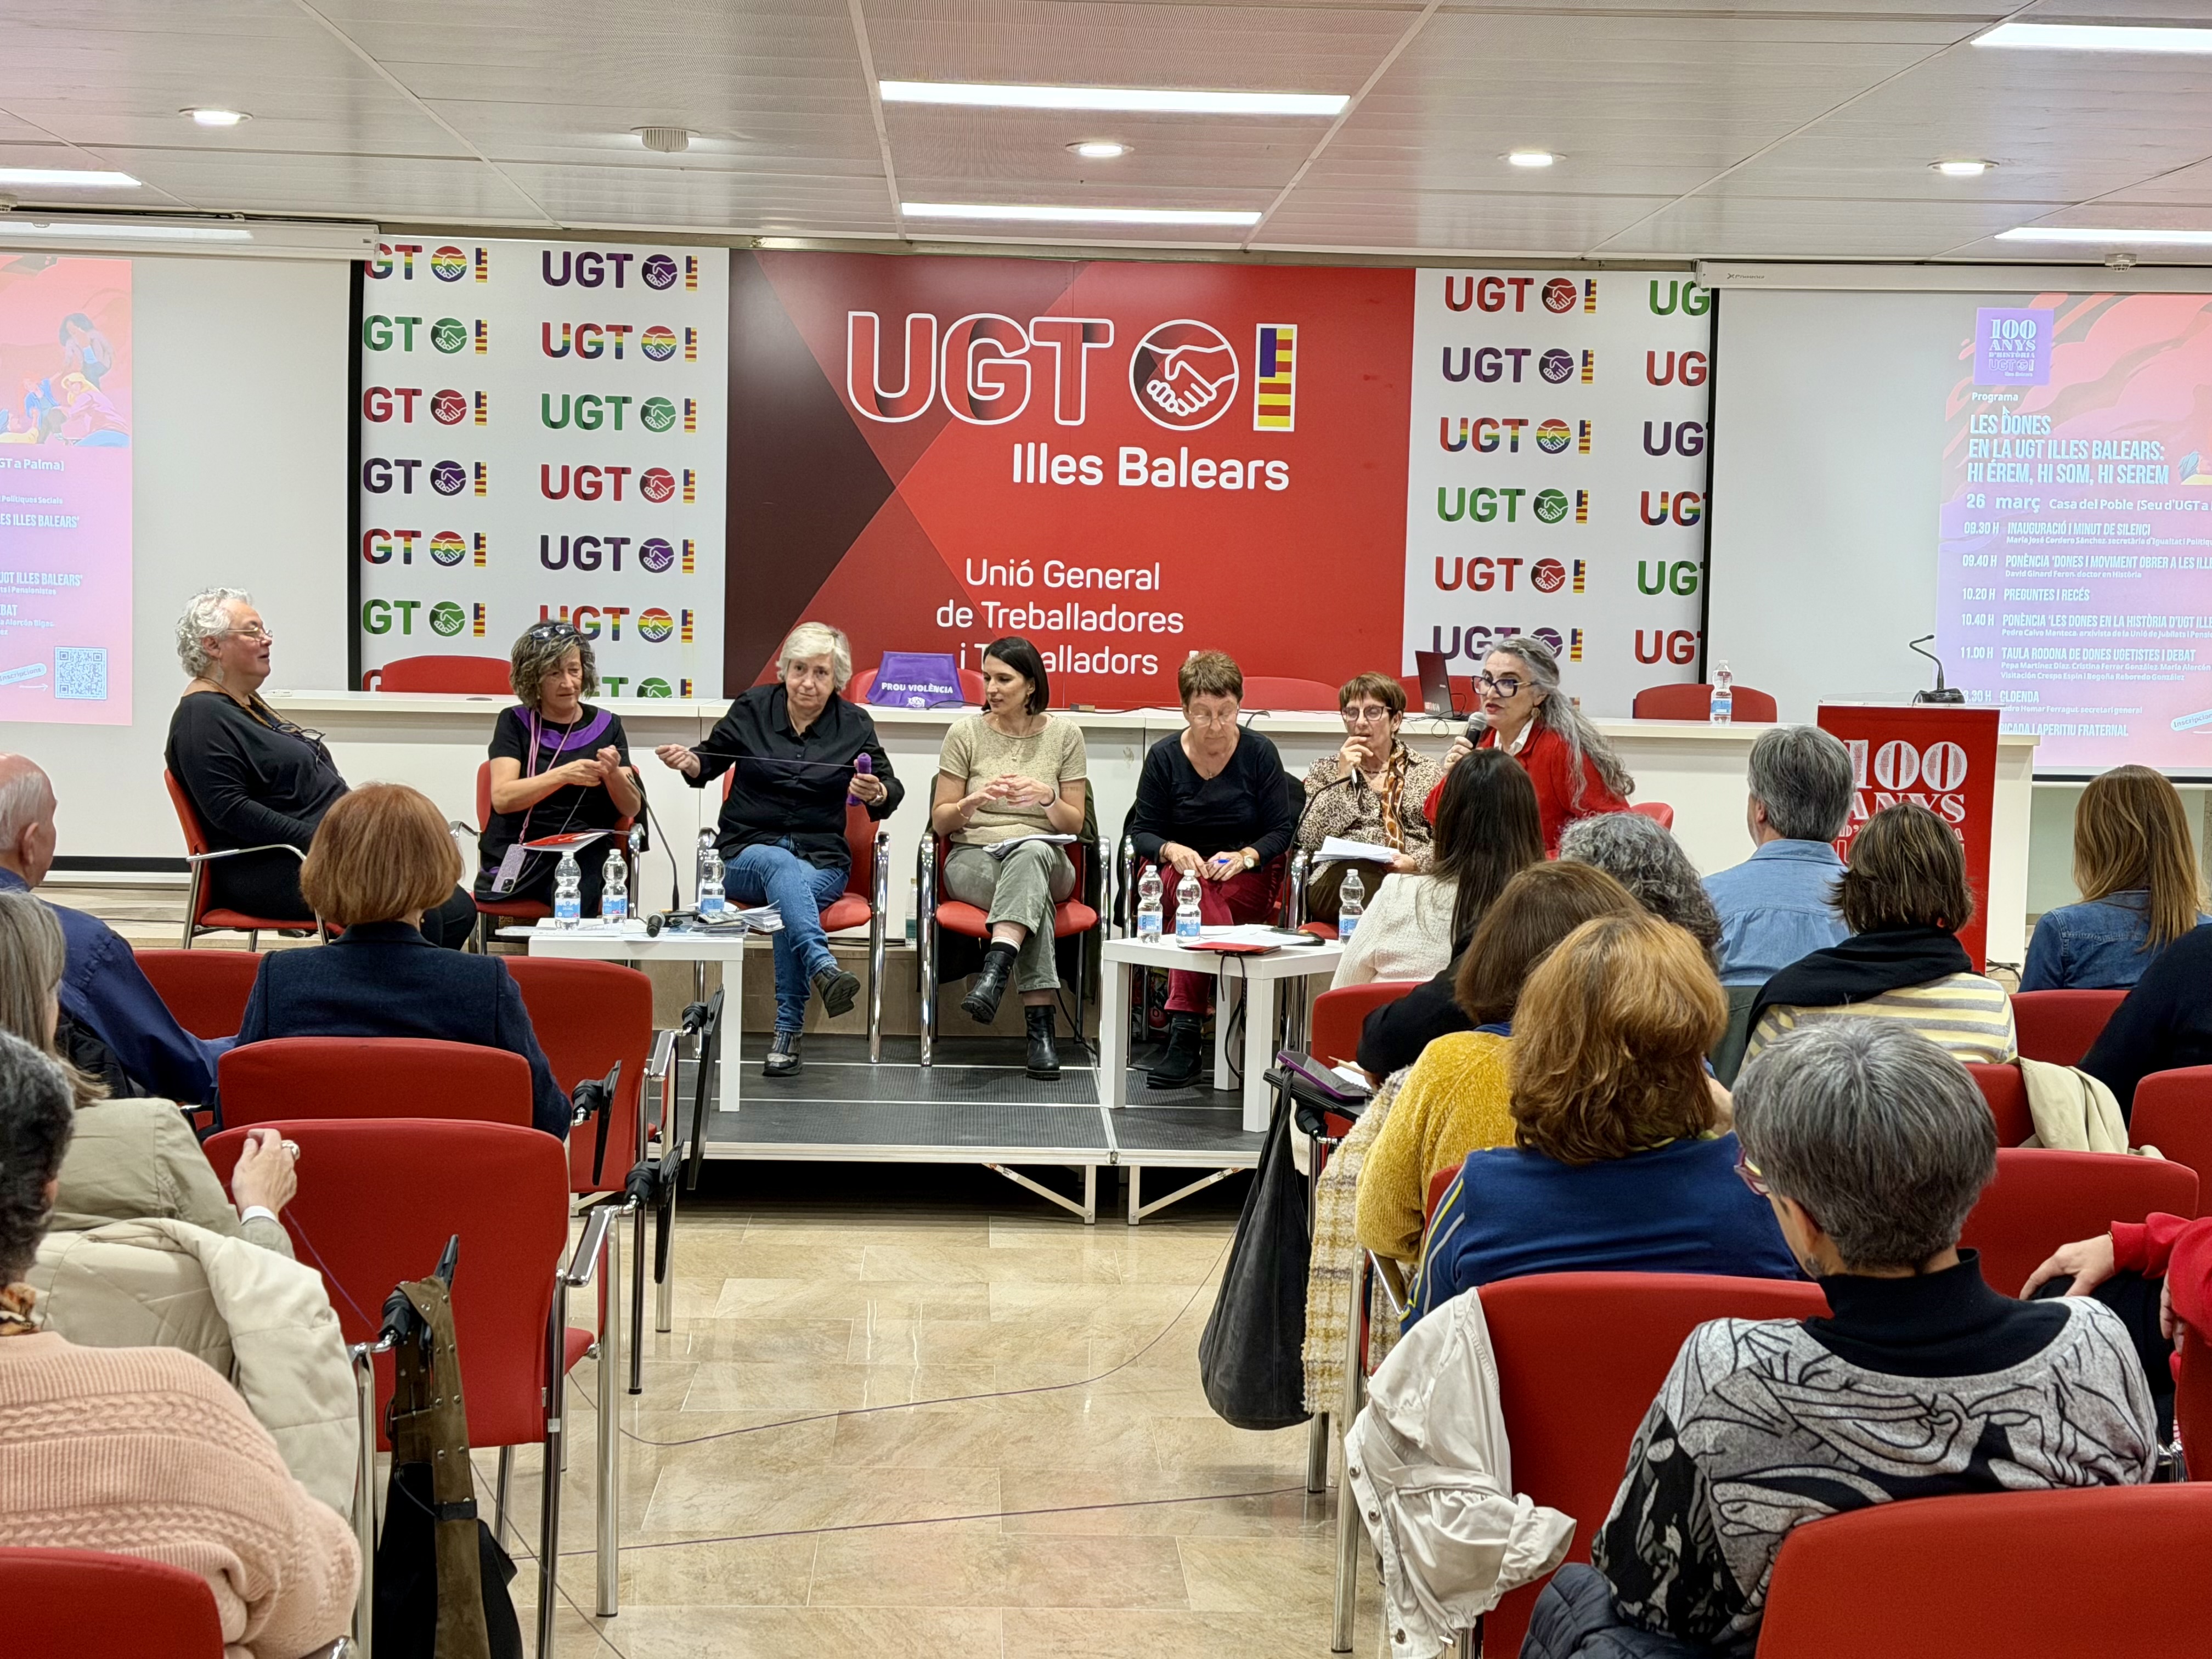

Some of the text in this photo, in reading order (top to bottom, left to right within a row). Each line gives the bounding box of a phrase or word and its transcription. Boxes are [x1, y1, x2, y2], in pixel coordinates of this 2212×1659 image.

[542, 250, 634, 289] UGT
[1445, 276, 1534, 312] UGT
[542, 322, 633, 360] UGT
[1989, 319, 2036, 340] 100
[1989, 340, 2036, 352] ANYS
[848, 311, 1114, 426] UGT
[1442, 347, 1531, 383] UGT
[541, 393, 633, 431] UGT
[1972, 392, 2018, 403] Programa
[1440, 417, 1528, 453] UGT
[1970, 414, 2052, 435] LES DONES
[1969, 438, 2165, 461] EN LA UGT ILLES BALEARS:
[541, 464, 631, 501] UGT
[1013, 442, 1290, 491] Illes Balears
[1967, 459, 2169, 486] HI ÉREM, HI SOM, HI SEREM
[1437, 487, 1526, 522] UGT
[1640, 491, 1707, 527] UG
[1966, 493, 1985, 509] 26
[1995, 496, 2041, 514] març
[2049, 498, 2077, 510] Casa
[2079, 499, 2097, 510] del
[2100, 499, 2134, 510] Poble
[2164, 499, 2200, 511] d'UGT
[2202, 503, 2209, 511] a
[0, 514, 11, 526] ES
[13, 514, 36, 526] ILLES
[1993, 522, 1999, 534] H
[2007, 520, 2067, 535] INAUGURACIÓ
[2073, 522, 2102, 535] MINUT
[2103, 523, 2115, 535] DE
[2117, 523, 2151, 536] SILENCI
[540, 534, 631, 572] UGT
[1962, 554, 1989, 567] 09.40
[1990, 555, 1997, 567] H
[2006, 553, 2050, 567] PONÈNCIA
[2090, 555, 2138, 568] MOVIMENT
[2140, 556, 2169, 569] OBRER
[2170, 556, 2176, 569] A
[2178, 556, 2195, 569] LES
[16, 572, 40, 584] ILLES
[966, 558, 1160, 590] Unió General
[1435, 556, 1523, 592] UGT
[1638, 561, 1703, 596] UG
[1962, 588, 1987, 600] 10.20
[1989, 588, 1995, 601] H
[2004, 588, 2055, 601] PREGUNTES
[2062, 586, 2090, 601] RECÉS
[0, 605, 18, 616] BAT
[936, 599, 1184, 634] de Treballadores
[1962, 613, 1985, 625] 10.40
[1988, 613, 1994, 626] H
[2002, 612, 2046, 626] PONÈNCIA
[2069, 615, 2097, 627] DONES
[2100, 615, 2111, 627] EN
[2113, 615, 2124, 627] LA
[2126, 613, 2166, 628] HISTÒRIA
[960, 642, 1158, 675] i Talladors
[1635, 629, 1701, 664] UG
[1961, 646, 1985, 658] 11.00
[1987, 646, 1993, 658] H
[2001, 647, 2029, 659] TAULA
[2032, 648, 2067, 659] RODONA
[2069, 648, 2081, 660] DE
[2083, 648, 2111, 660] DONES
[2113, 649, 2160, 661] UGETISTES
[2167, 650, 2196, 661] DEBAT
[881, 682, 953, 693] PROU VIOLÈNCIA
[1985, 690, 2039, 703] H CLOENDA
[1843, 740, 1968, 792] 100
